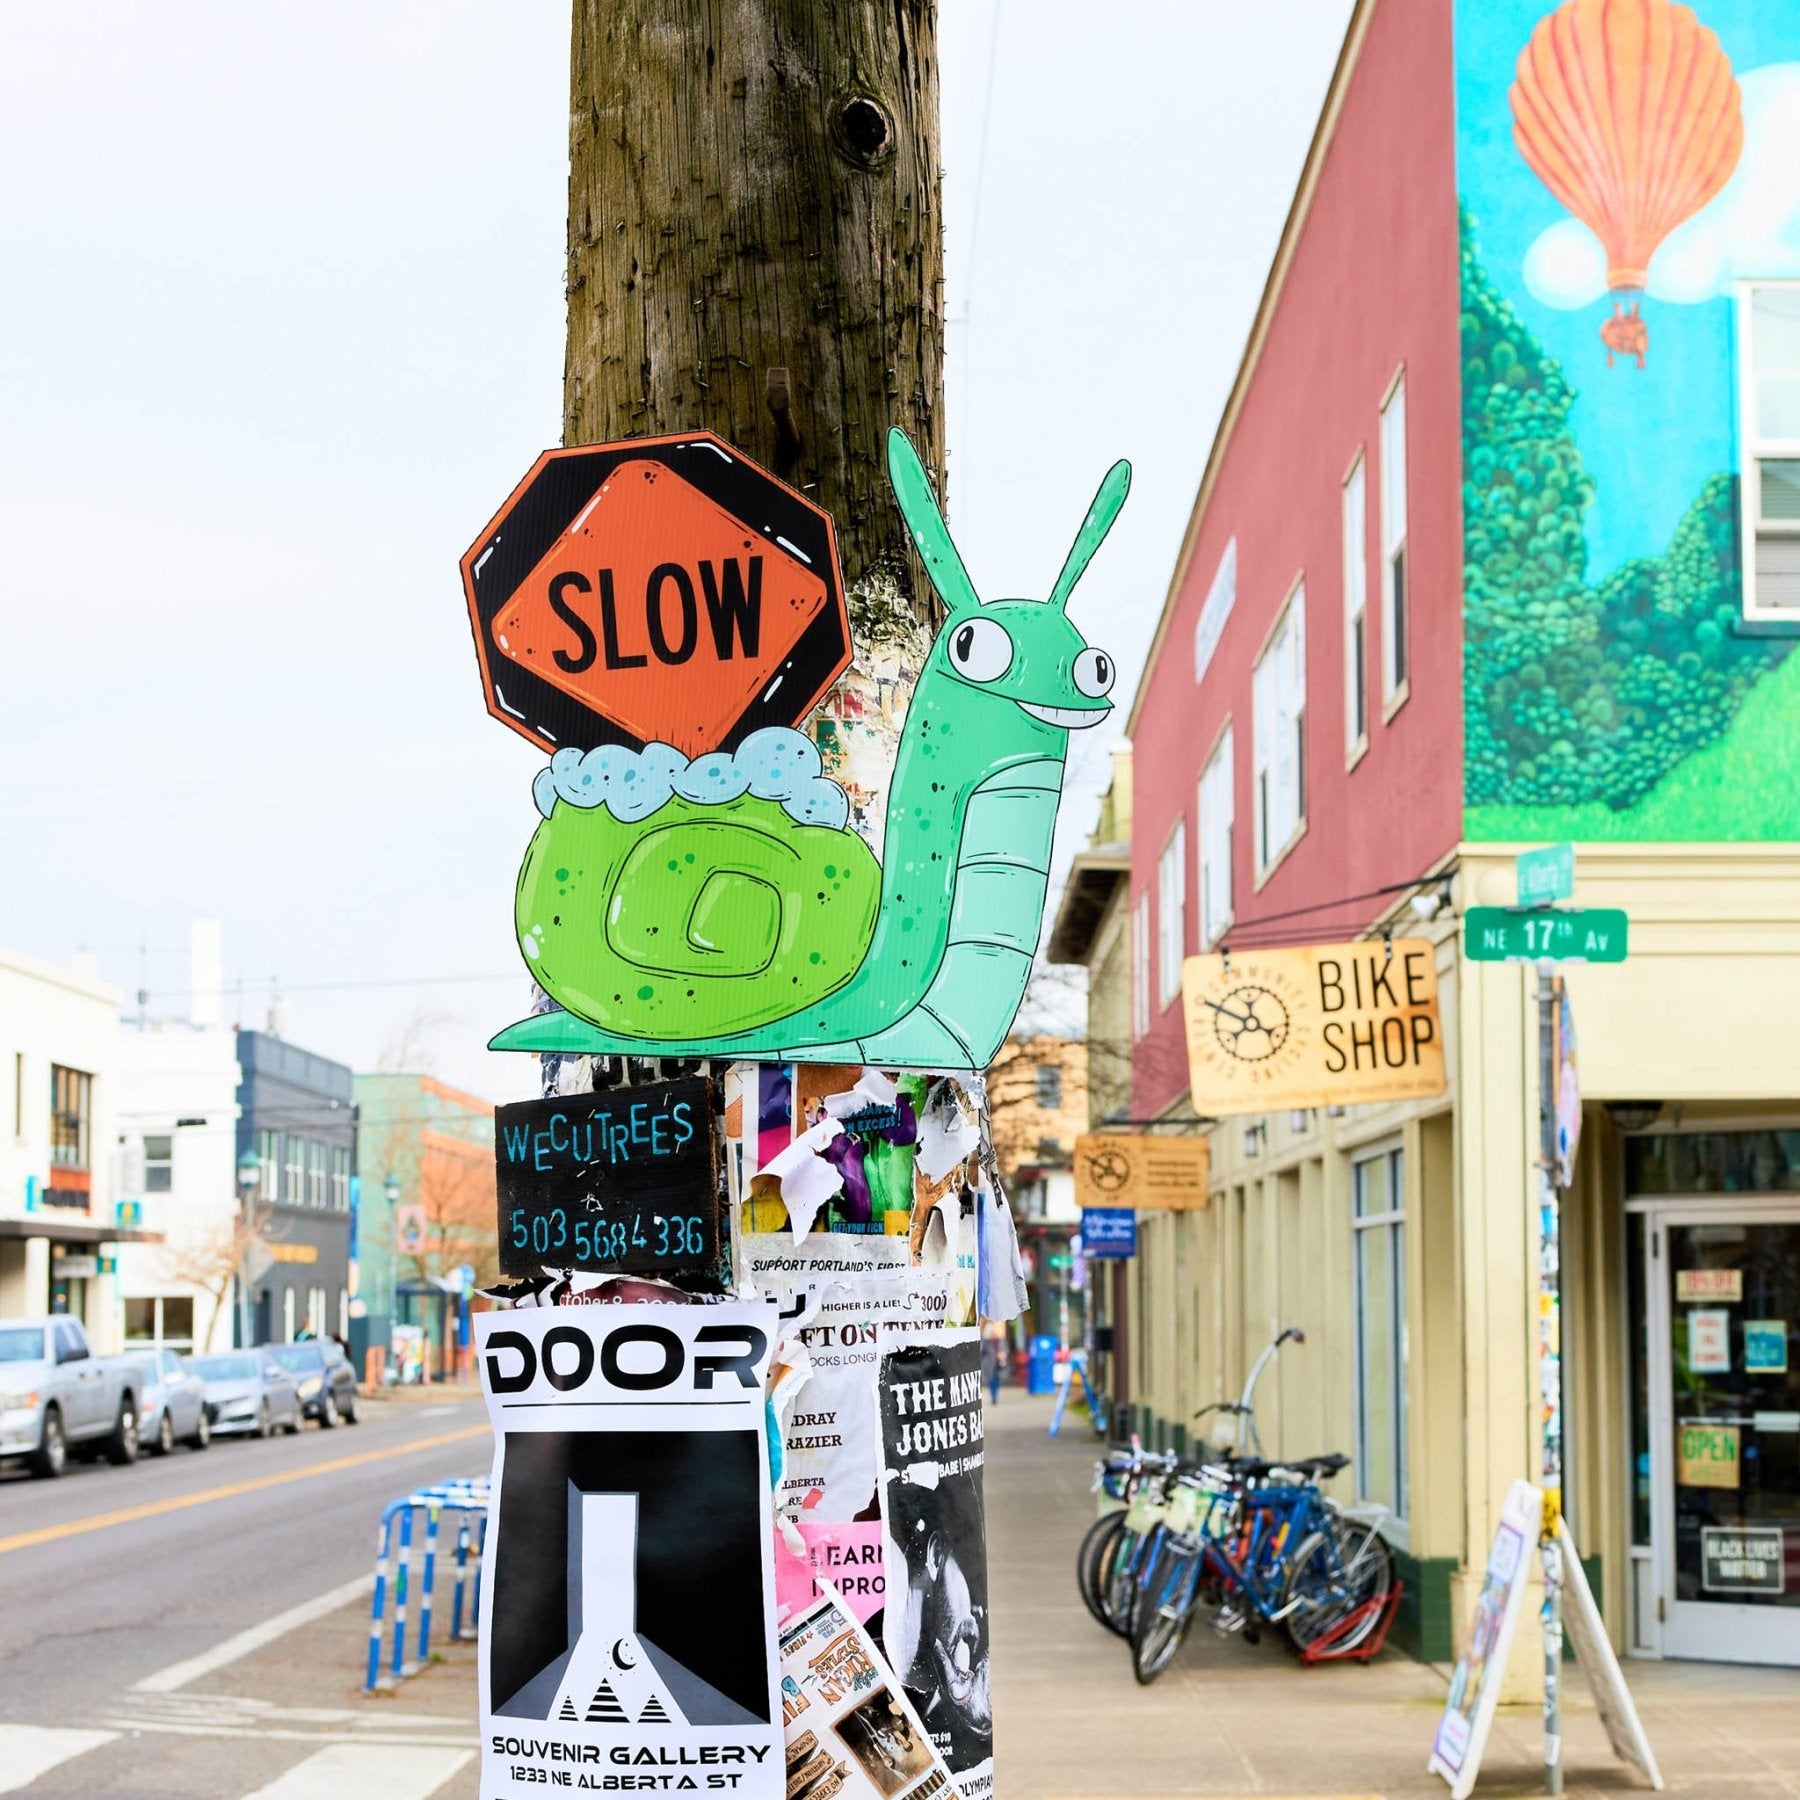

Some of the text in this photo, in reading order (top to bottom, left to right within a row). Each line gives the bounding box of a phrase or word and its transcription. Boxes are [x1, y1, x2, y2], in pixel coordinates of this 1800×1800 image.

[547, 555, 764, 675] SLOW
[1483, 919, 1609, 951] NE 17th Av
[1318, 952, 1430, 1012] BIKE
[1323, 1015, 1434, 1073] SHOP
[752, 1259, 807, 1272] SUPPORT
[809, 1259, 873, 1272] PORTLAND'S
[821, 1300, 901, 1312] HIGHER IS A LIE!
[840, 1323, 880, 1346] ON
[485, 1324, 768, 1394] DOOR
[890, 1379, 947, 1415] THE
[791, 1412, 837, 1426] DRAY
[896, 1416, 968, 1456] JONES
[1683, 1429, 1735, 1461] OPEN
[939, 1460, 960, 1478] BABE
[782, 1478, 826, 1490] LBERTA
[1707, 1539, 1779, 1560] BLACK LIVES
[1719, 1559, 1767, 1580] MATTER
[812, 1576, 885, 1597] IPRO
[492, 1736, 771, 1765] SOUVENIR GALLERY
[510, 1766, 743, 1790] 1233 NE ALBERTA ST
[958, 1774, 993, 1797] LYMPIA
